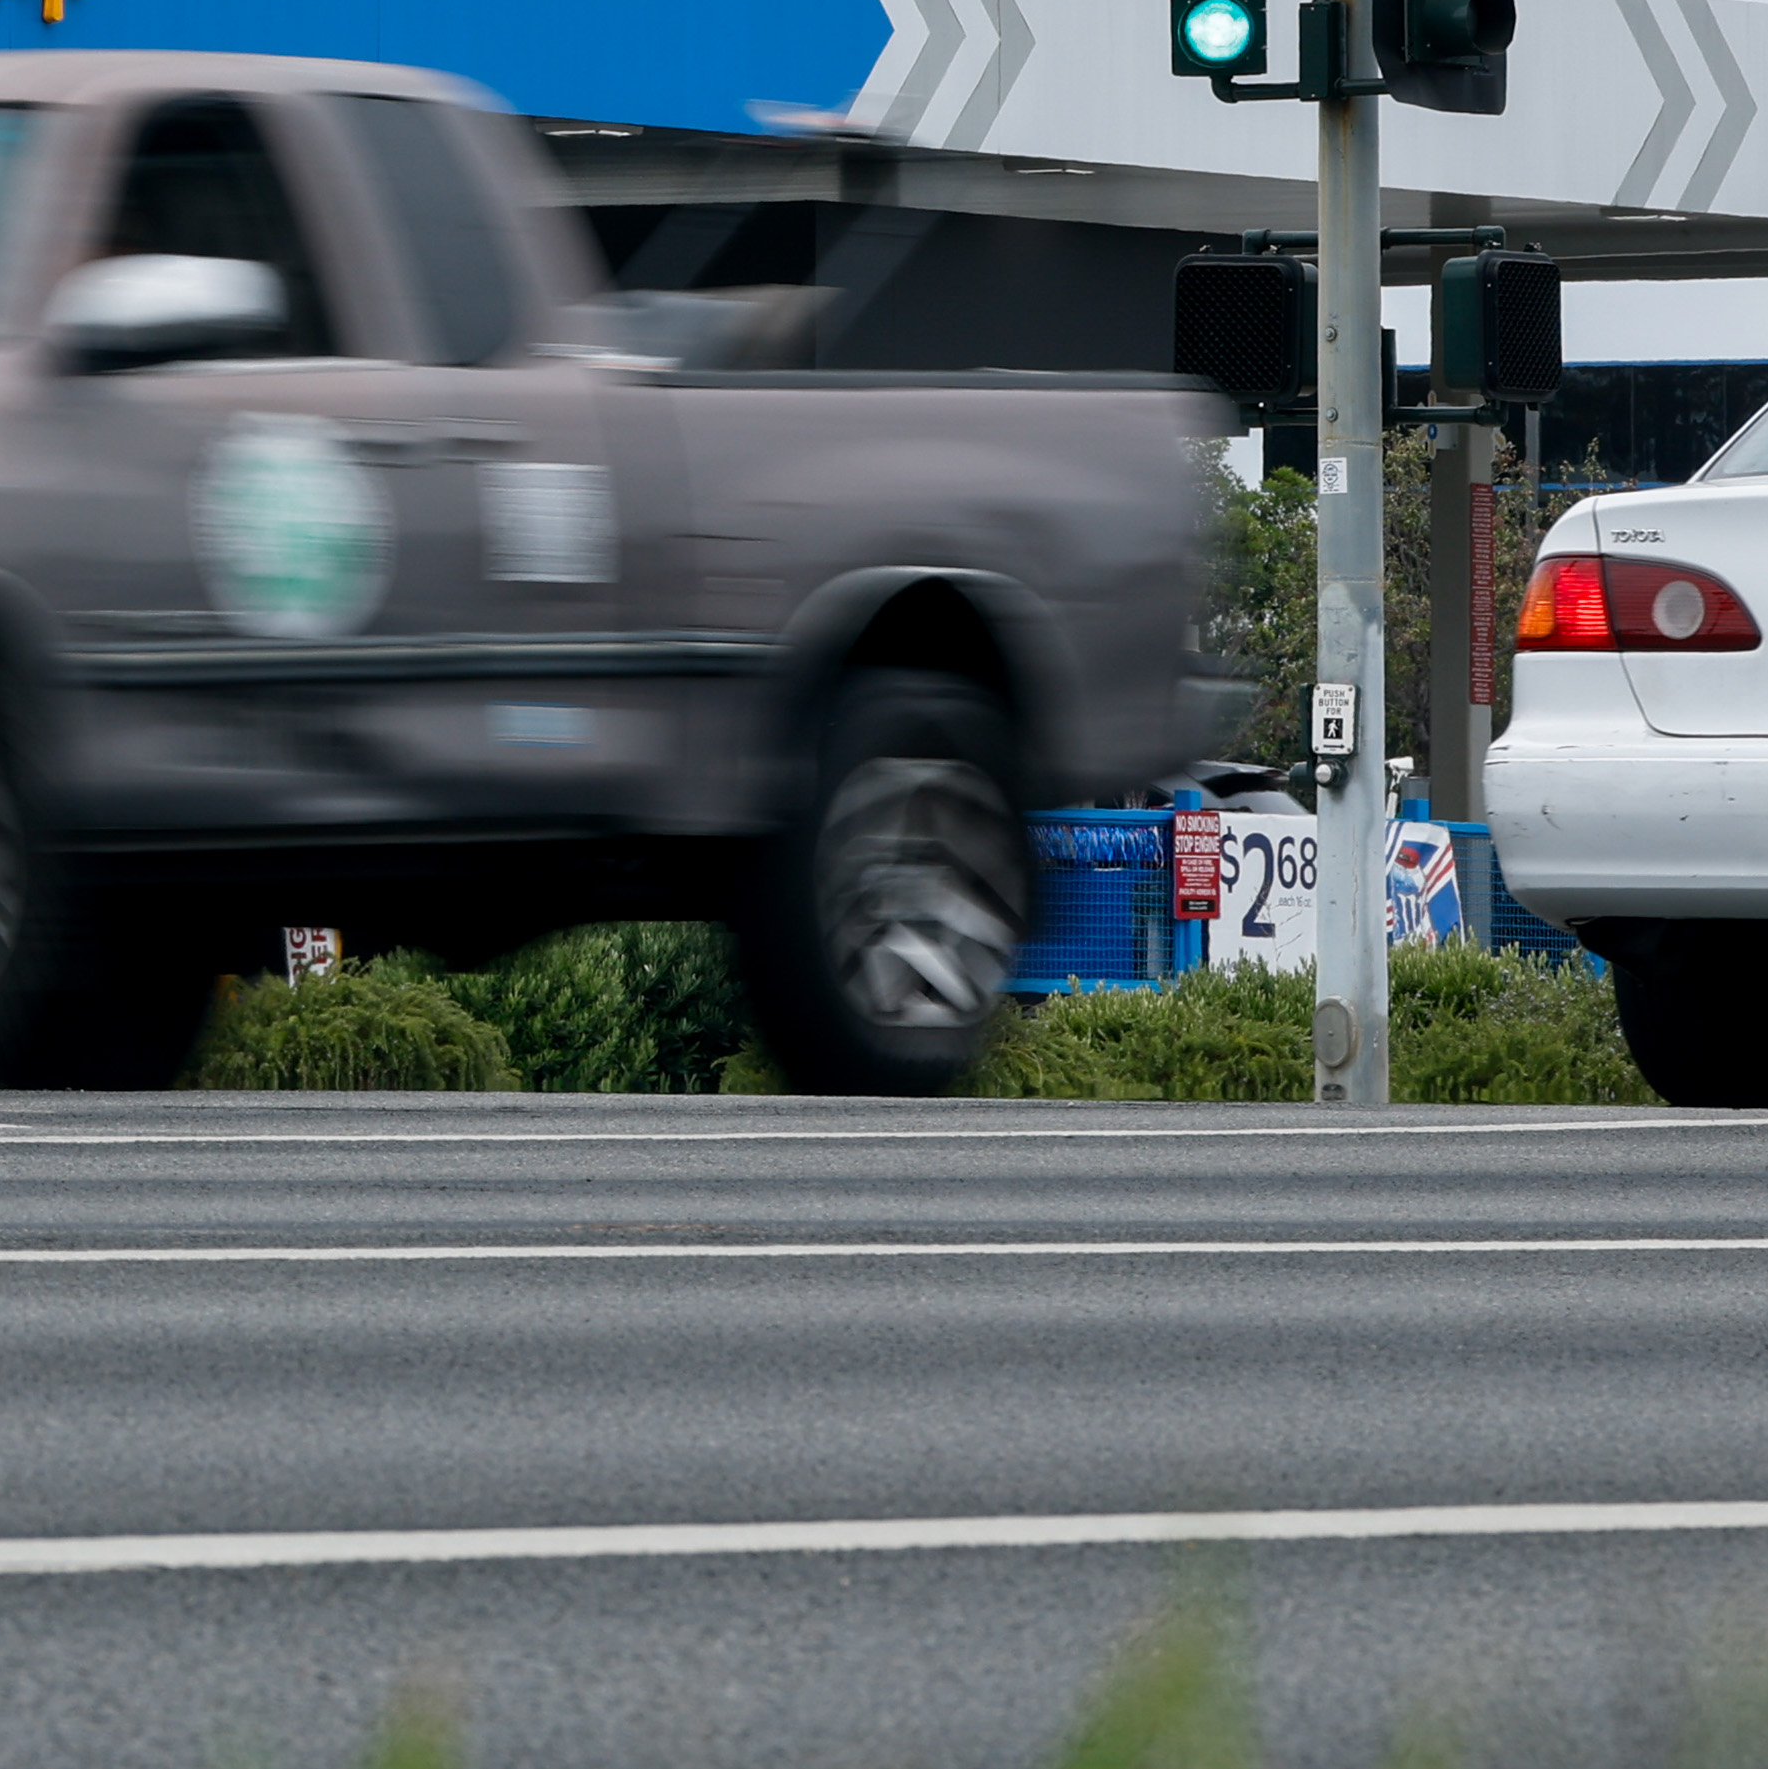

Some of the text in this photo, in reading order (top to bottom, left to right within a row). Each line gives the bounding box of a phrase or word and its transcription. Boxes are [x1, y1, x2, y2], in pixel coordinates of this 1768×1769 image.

[1610, 529, 1666, 543] TOYOTA
[1323, 689, 1346, 698] PUSH
[1319, 698, 1350, 707] BUTTON
[1326, 707, 1342, 715] FOR
[1175, 815, 1219, 832] NO SMOKING
[1175, 835, 1220, 852] STOP ENGINE
[1279, 896, 1295, 907] each
